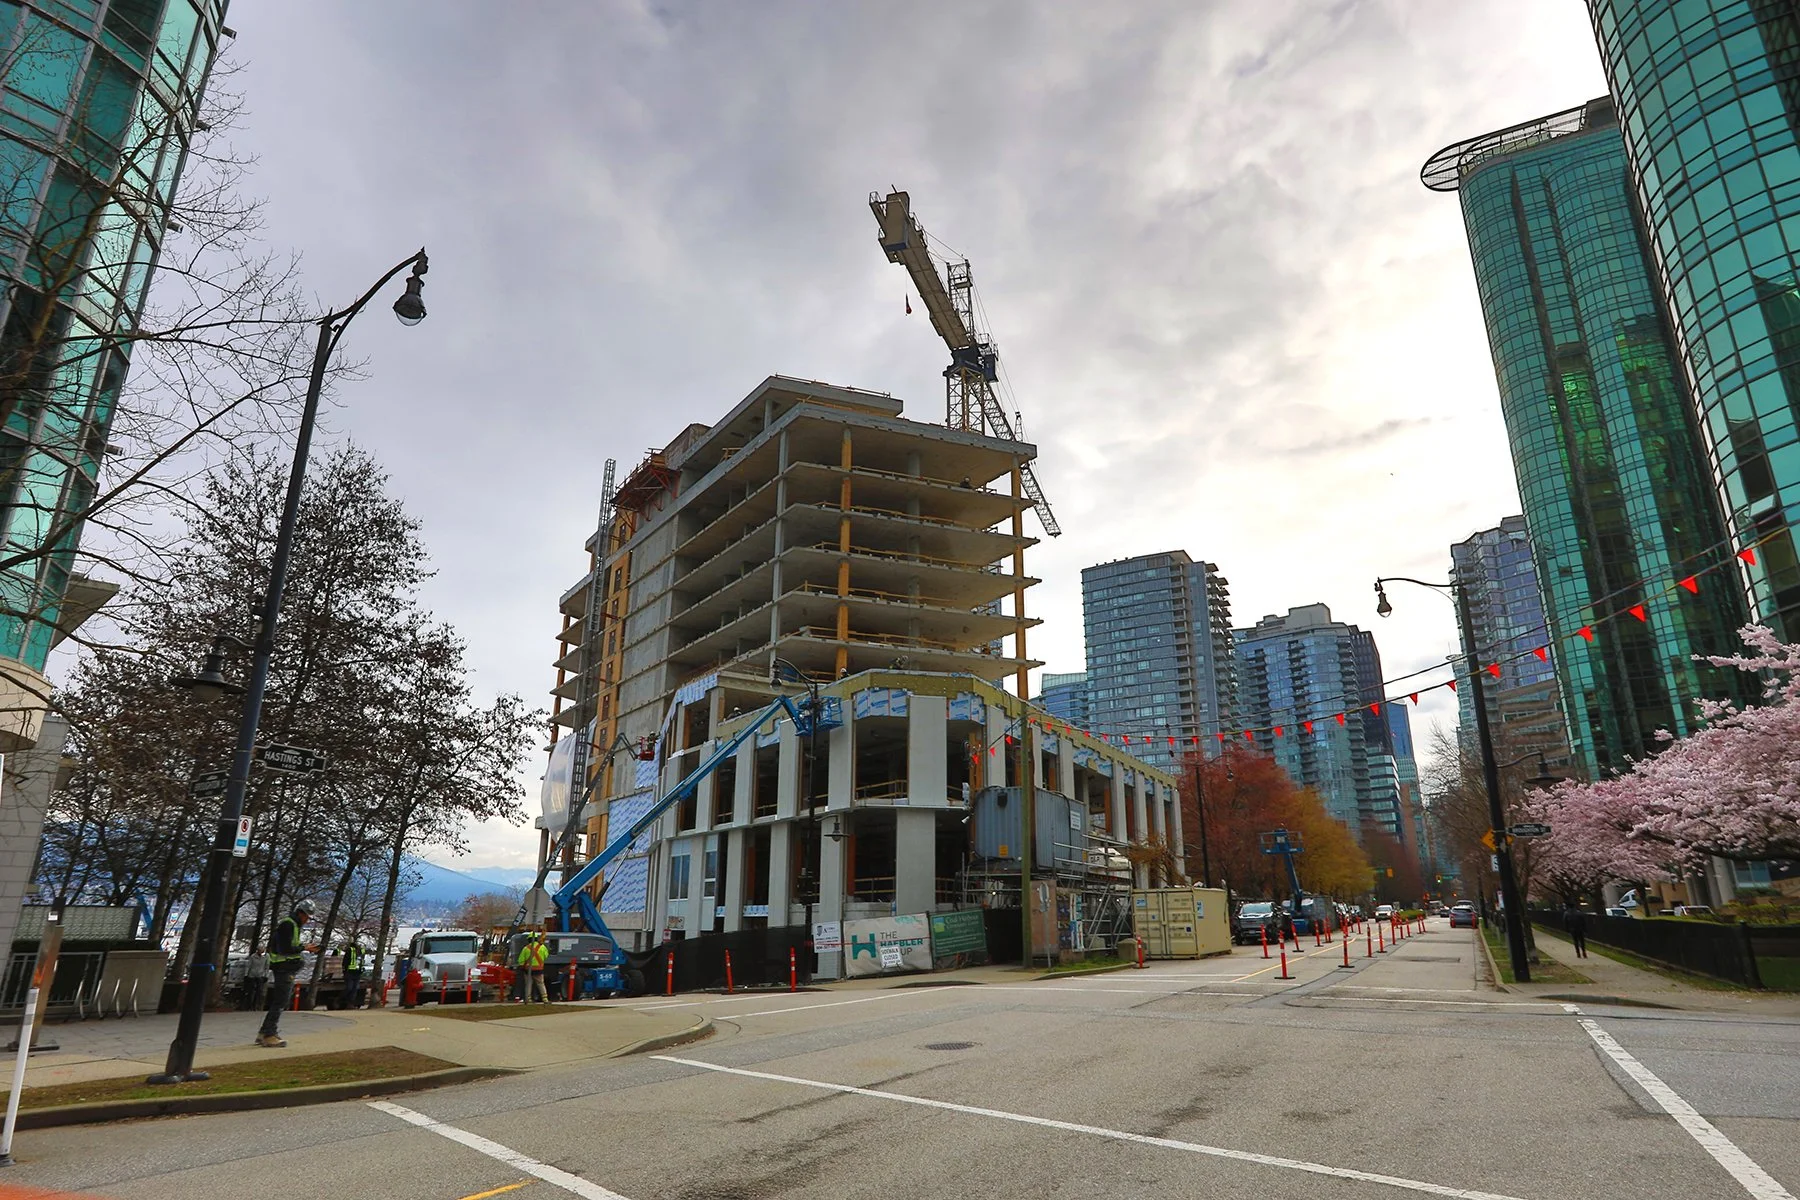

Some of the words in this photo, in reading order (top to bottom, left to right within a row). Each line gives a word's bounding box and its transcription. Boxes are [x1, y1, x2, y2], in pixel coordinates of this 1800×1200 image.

[264, 750, 303, 765] HASTINGS
[305, 757, 315, 767] ST
[880, 931, 898, 939] THE
